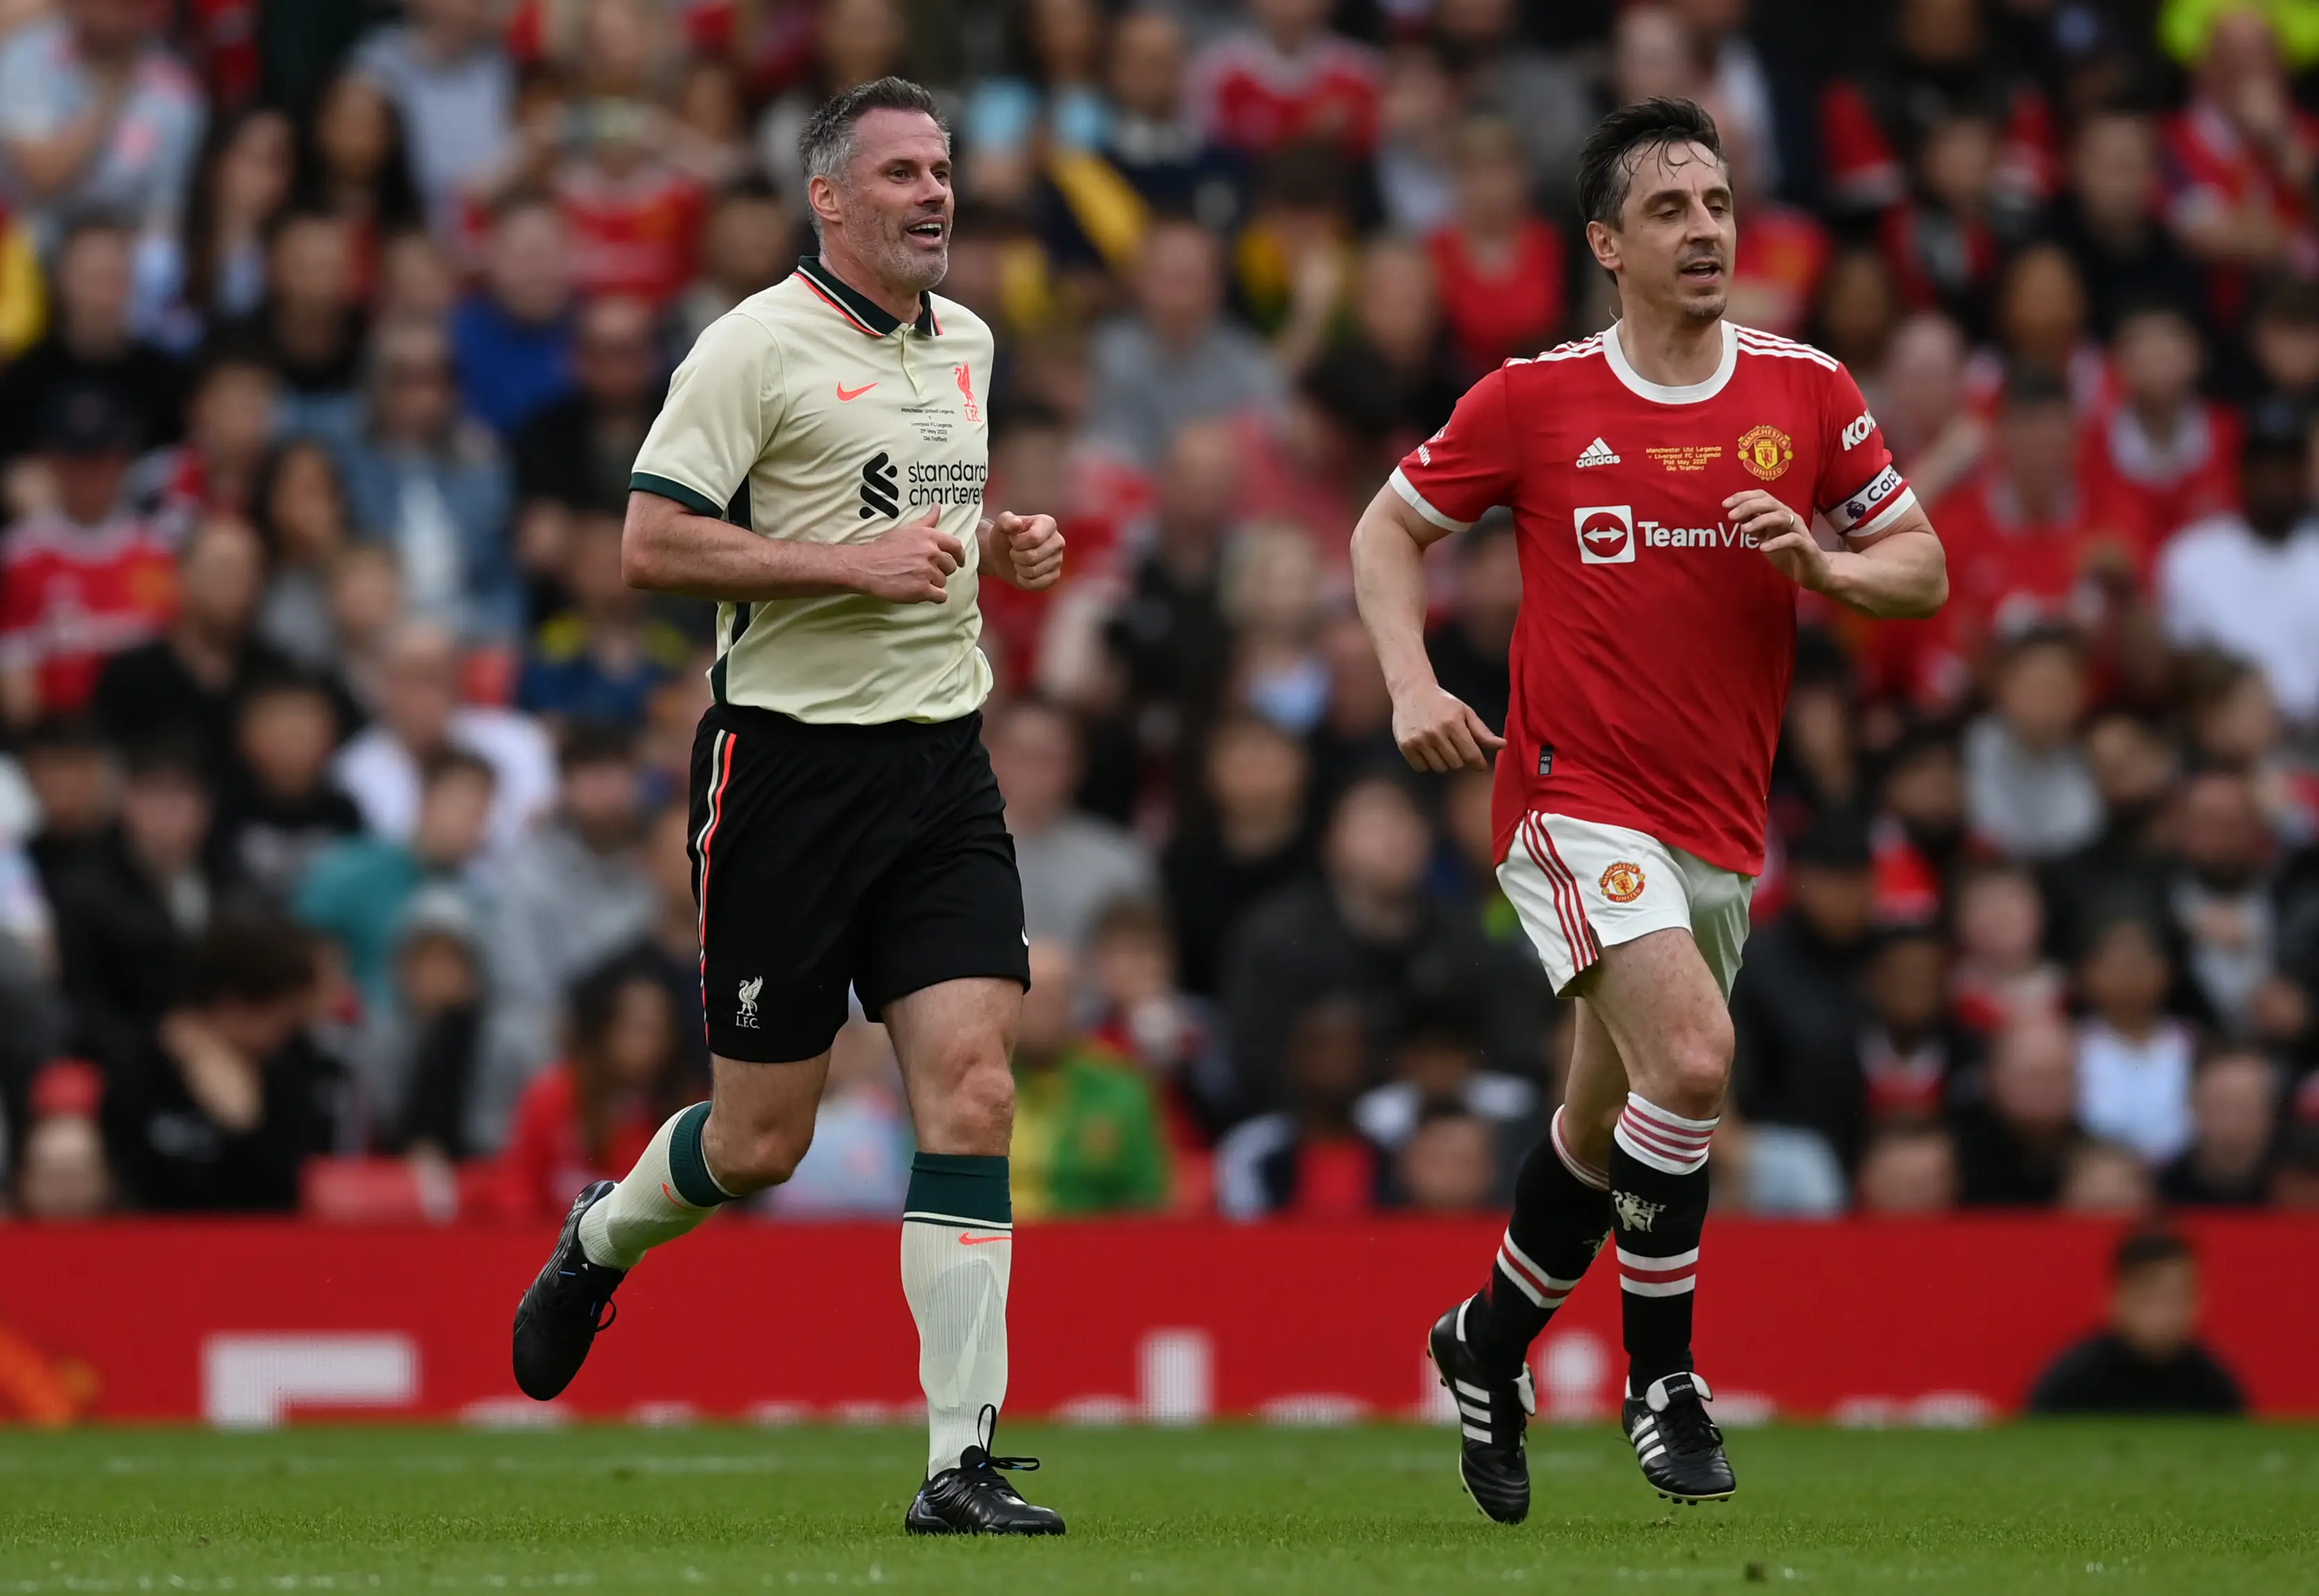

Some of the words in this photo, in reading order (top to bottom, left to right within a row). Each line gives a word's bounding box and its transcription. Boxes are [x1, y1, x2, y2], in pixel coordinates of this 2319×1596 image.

[1742, 429, 1787, 447] MANCHESTER
[1841, 407, 1876, 451] KOH
[908, 459, 986, 483] standard
[1576, 455, 1621, 468] adidas
[1753, 466, 1782, 477] UNITED
[909, 482, 984, 506] chartere
[1867, 468, 1900, 502] Cap
[1637, 521, 1760, 549] TeamVie
[1668, 1383, 1693, 1395] adidas
